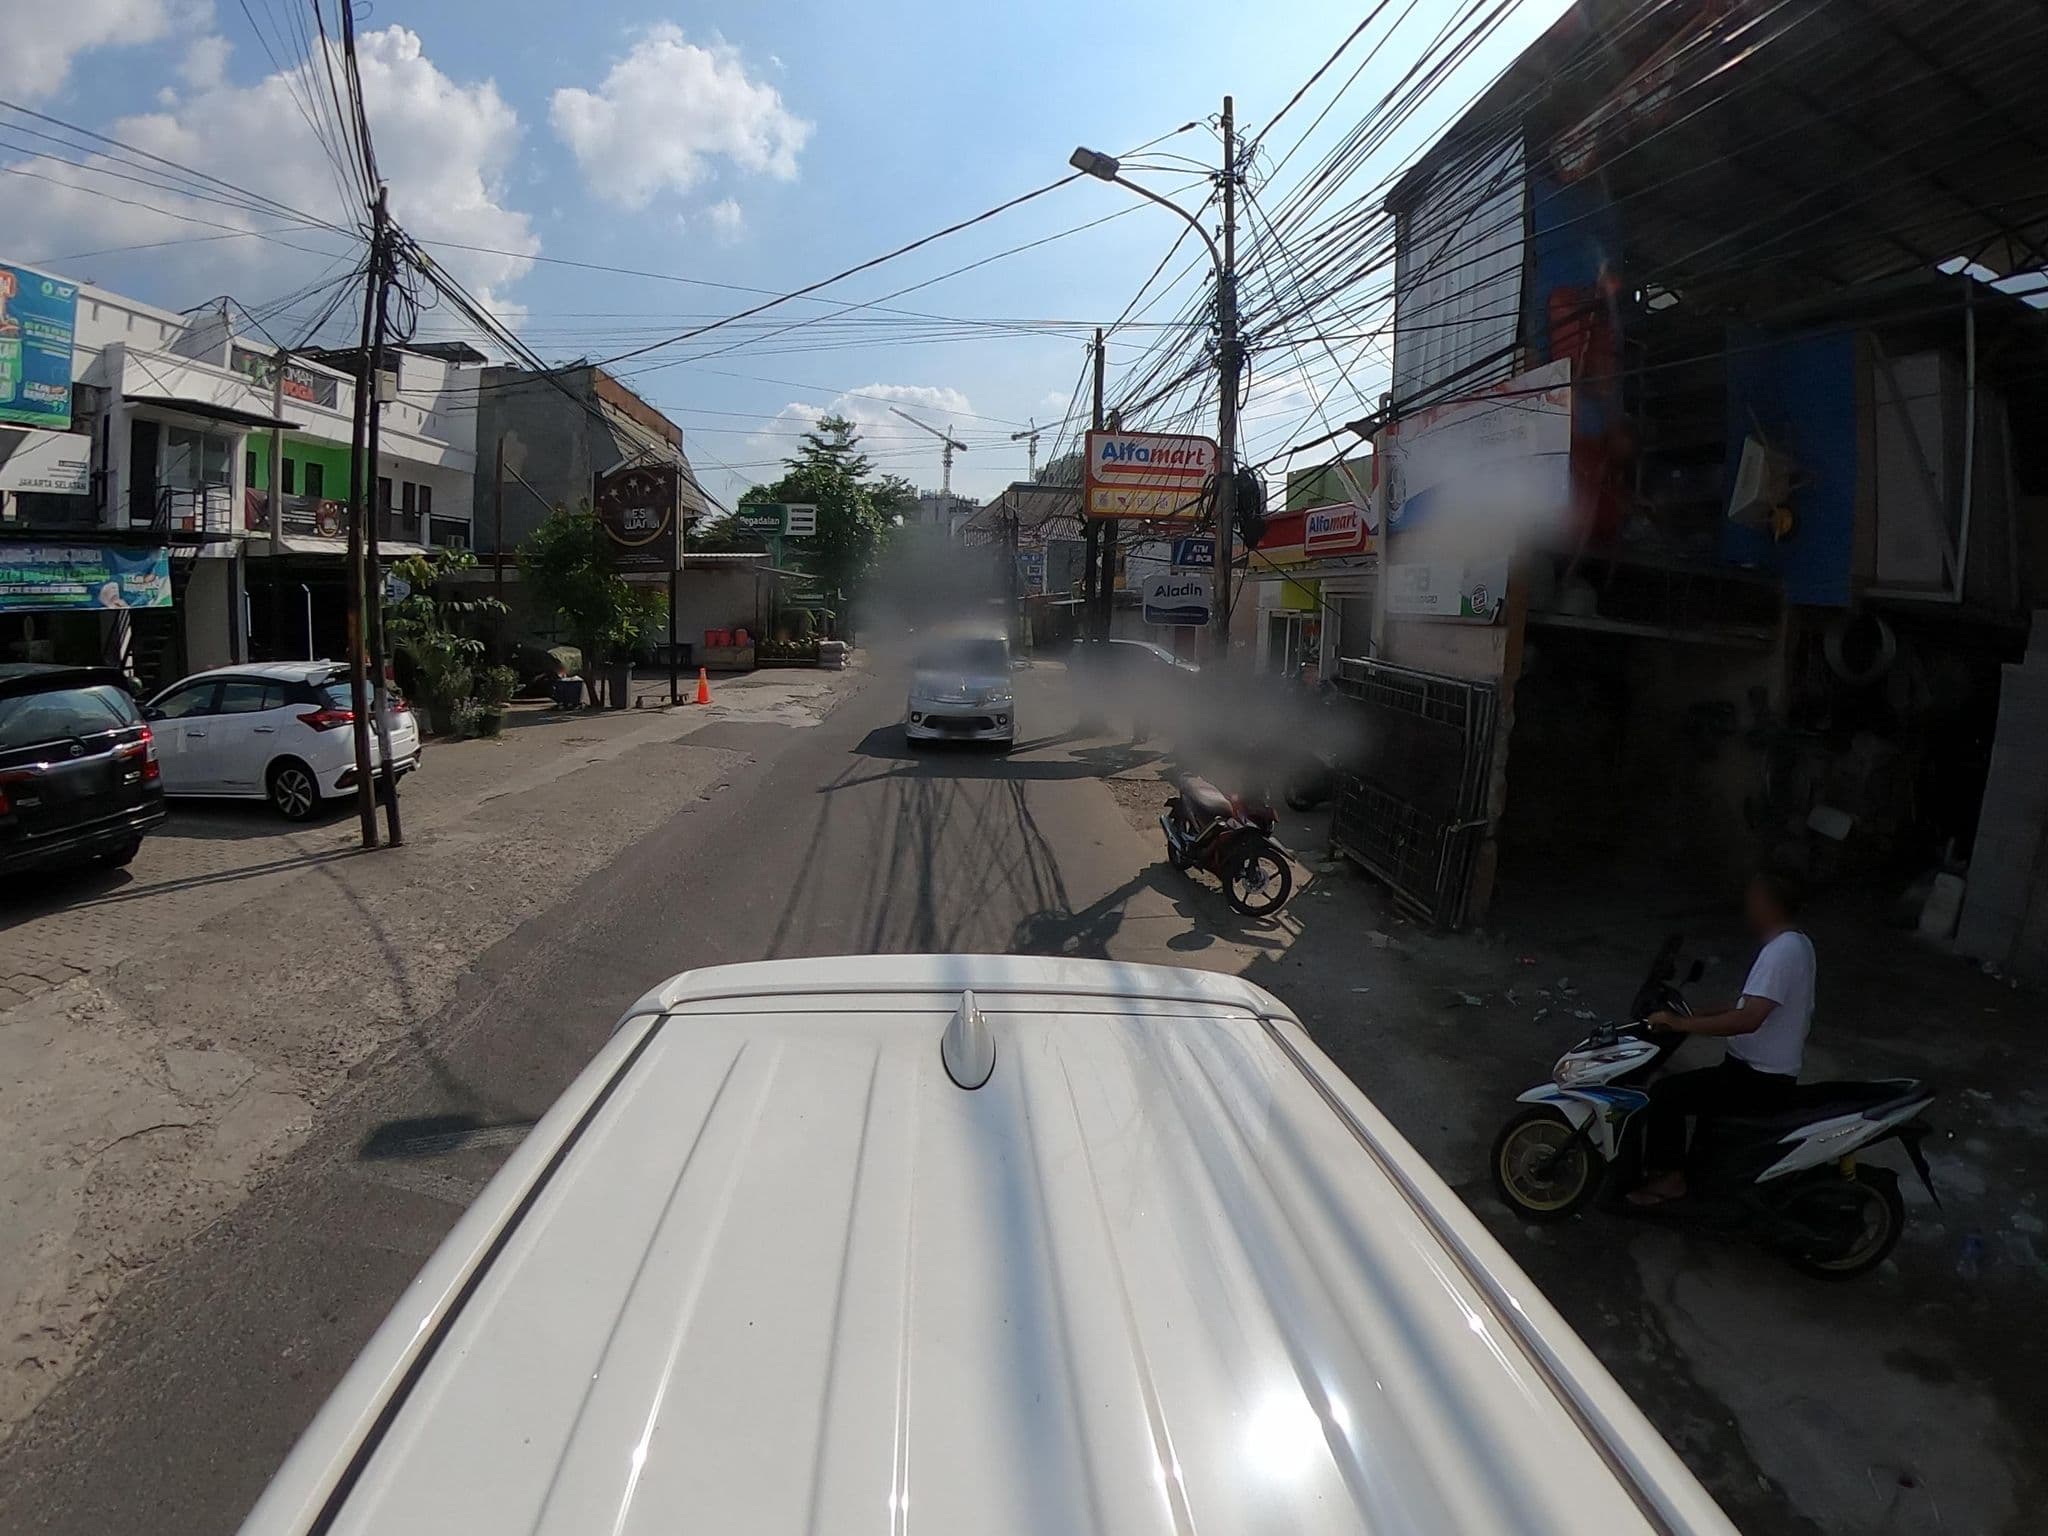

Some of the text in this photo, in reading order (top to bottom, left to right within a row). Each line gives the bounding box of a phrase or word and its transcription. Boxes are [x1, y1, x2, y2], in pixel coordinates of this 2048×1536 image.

[1101, 441, 1206, 466] Alfamart
[18, 478, 87, 490] JAKARTA SELATAN
[739, 516, 780, 527] Pegadaian
[1309, 511, 1359, 533] Alfamart
[1191, 544, 1209, 554] ATM
[1154, 583, 1203, 598] Aladin
